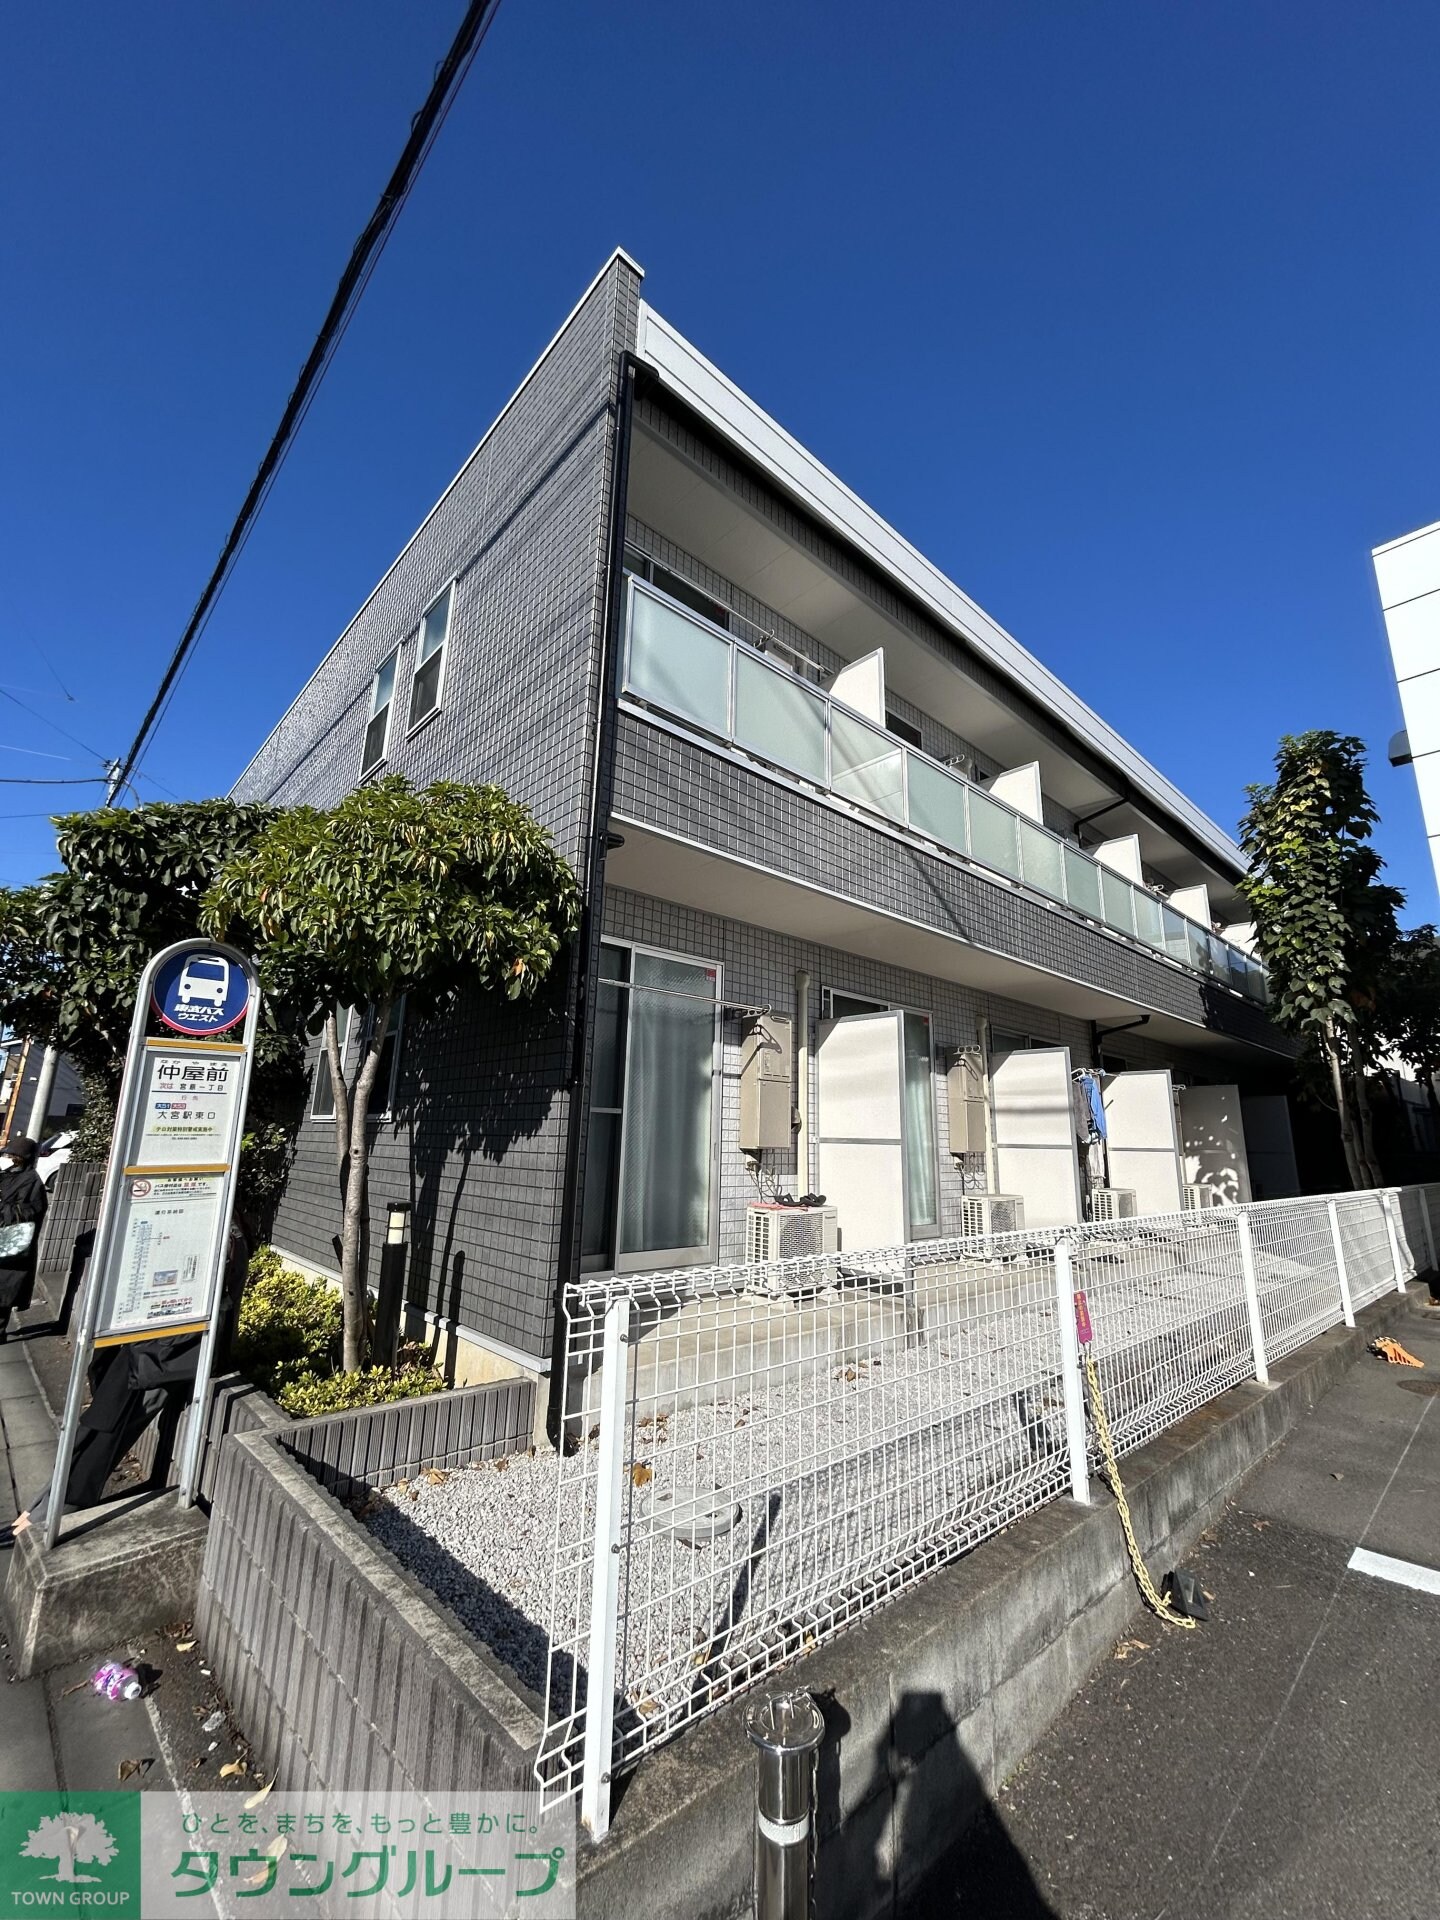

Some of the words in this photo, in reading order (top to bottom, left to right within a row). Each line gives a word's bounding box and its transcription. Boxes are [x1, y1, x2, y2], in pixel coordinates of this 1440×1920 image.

[178, 1013, 219, 1023] ウエスト
[157, 1064, 229, 1082] 仲屋前
[157, 1111, 216, 1120] 大宮駅東口
